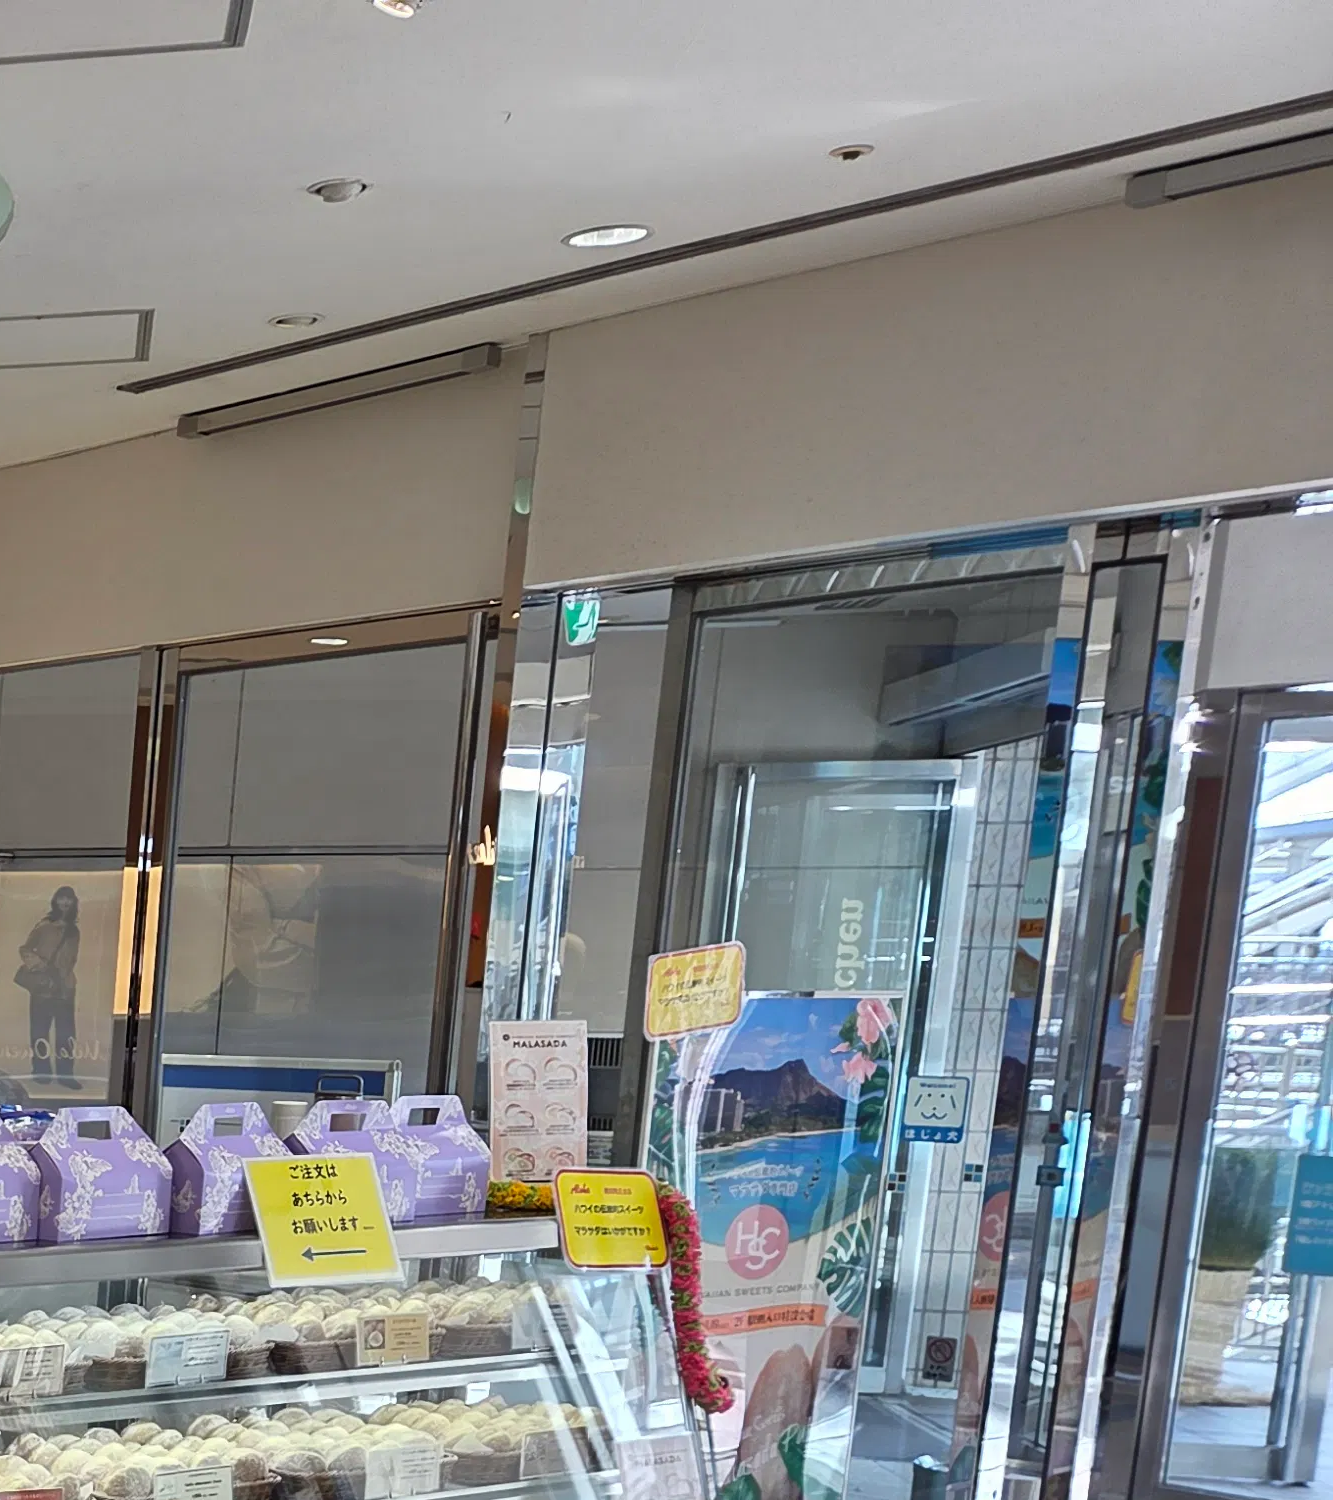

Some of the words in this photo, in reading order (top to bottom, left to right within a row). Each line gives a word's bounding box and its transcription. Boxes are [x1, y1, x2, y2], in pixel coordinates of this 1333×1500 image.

[513, 1040, 568, 1048] MALASADA
[289, 1164, 339, 1179] ご注文は
[292, 1190, 347, 1207] あちらから
[292, 1216, 359, 1234] お願いします
